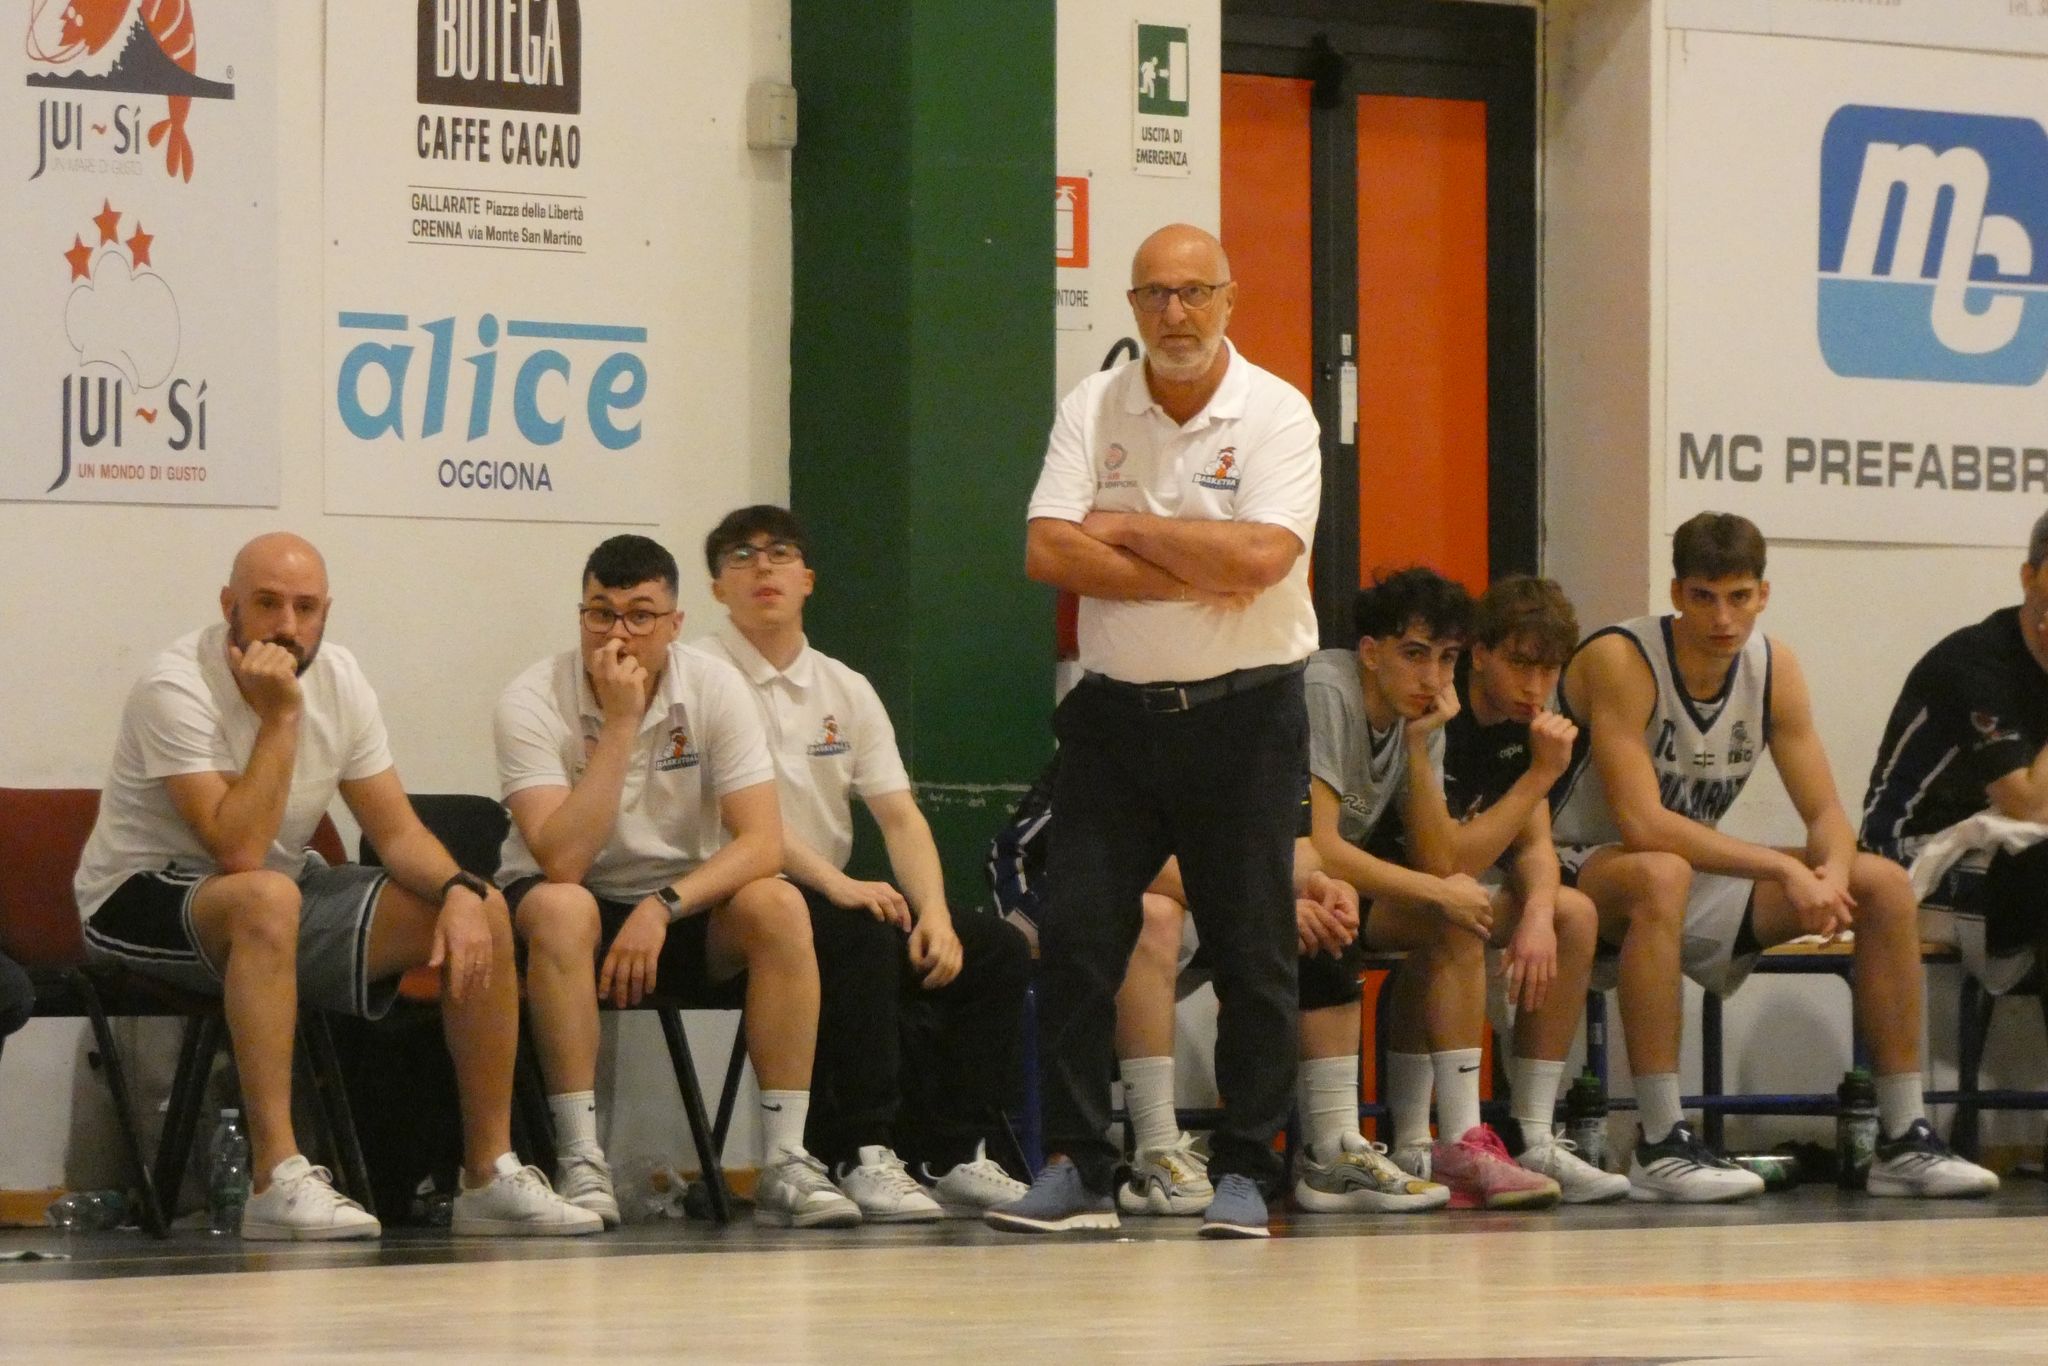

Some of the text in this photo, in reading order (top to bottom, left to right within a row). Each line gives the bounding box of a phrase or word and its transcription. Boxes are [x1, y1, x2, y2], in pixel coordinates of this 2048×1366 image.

[417, 114, 581, 169] CAFFE CACAO
[1141, 126, 1182, 143] USCITA DI
[1136, 148, 1188, 167] EMERGENZA
[411, 193, 584, 221] GALLARATE Piazza della Libertà
[412, 219, 583, 247] CRENNA via Monte San Martino
[337, 313, 647, 450] alice
[78, 463, 207, 481] UN MONDO DI GUSTO
[438, 459, 552, 491] OGGIONA
[1679, 432, 2048, 493] MC PREFABBR
